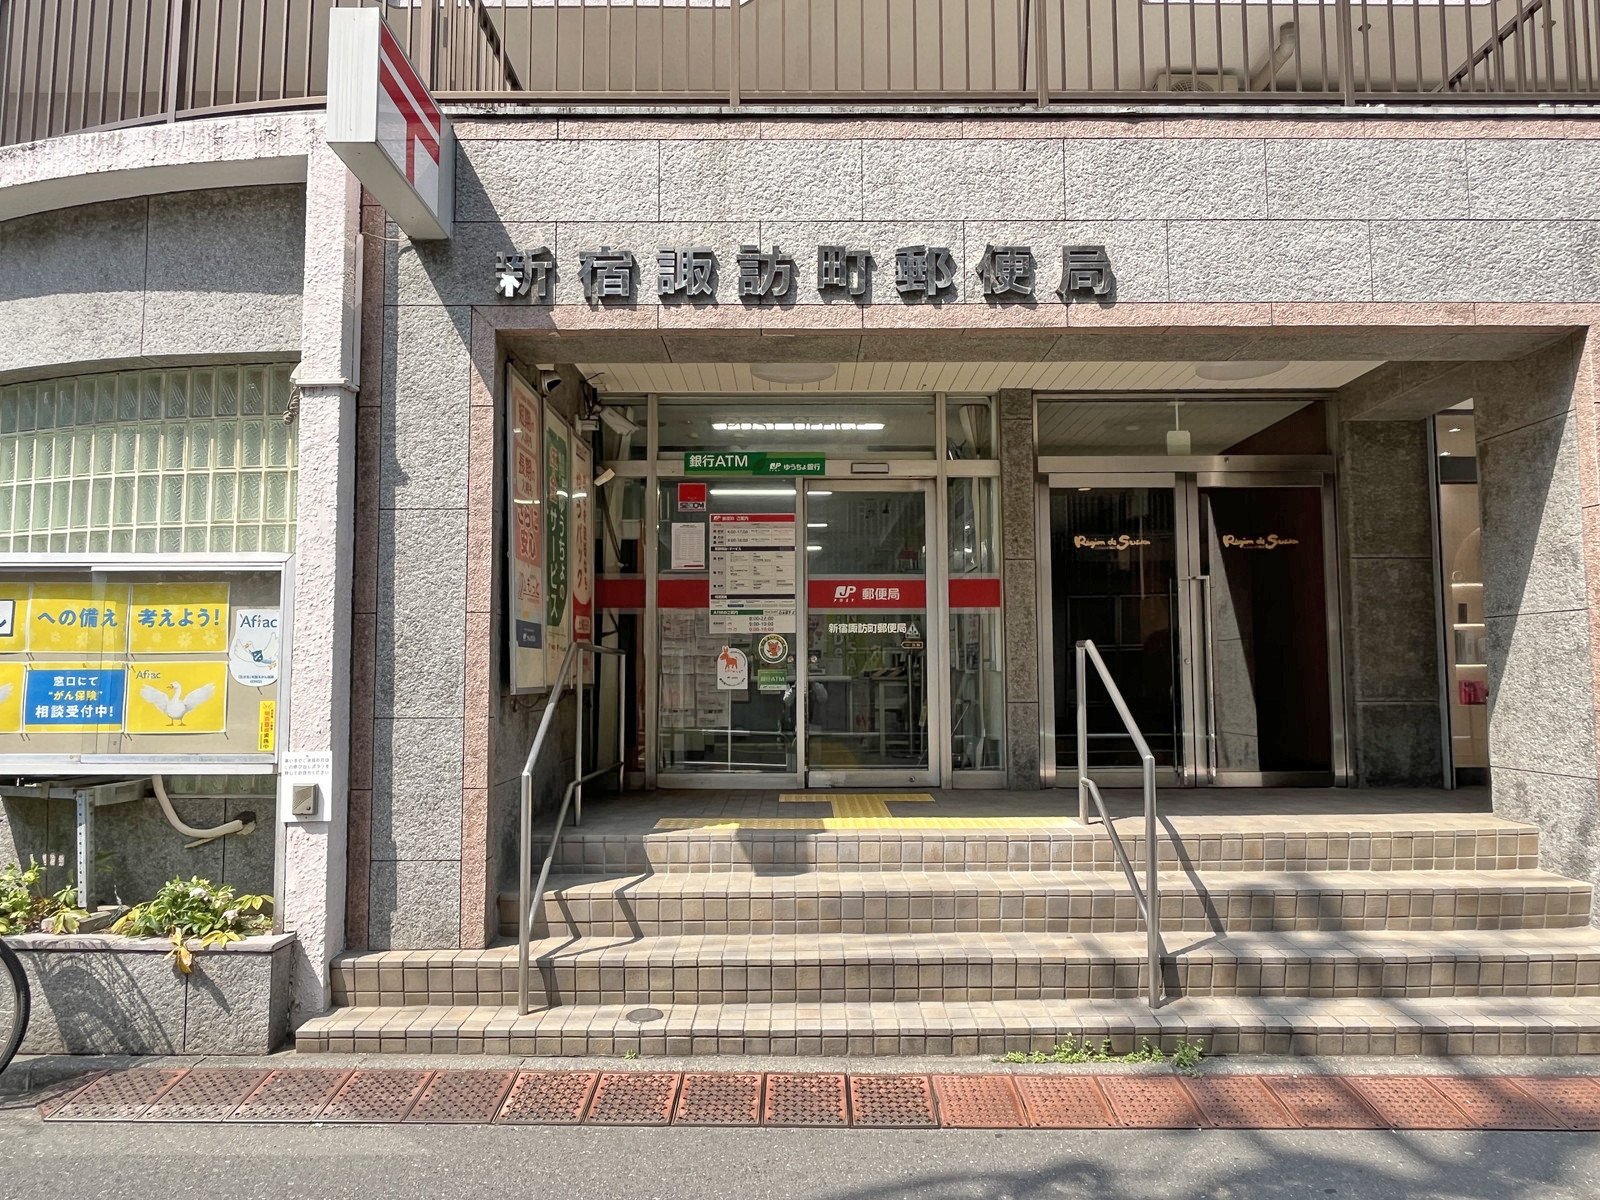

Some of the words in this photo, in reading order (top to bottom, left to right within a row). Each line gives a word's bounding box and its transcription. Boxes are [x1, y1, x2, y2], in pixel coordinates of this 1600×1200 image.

[495, 243, 1112, 299] 新宿諏訪町郵便局
[689, 454, 748, 467] 銀行ATM
[783, 462, 821, 471] ゆうちょ銀行
[861, 588, 900, 600] 郵便局
[37, 607, 118, 628] への備え
[137, 608, 220, 628] 考えよう!
[828, 623, 907, 634] 新宿諏訪町郵便局
[53, 676, 99, 687] 窓口にて
[35, 705, 114, 718] 相談受付中!
